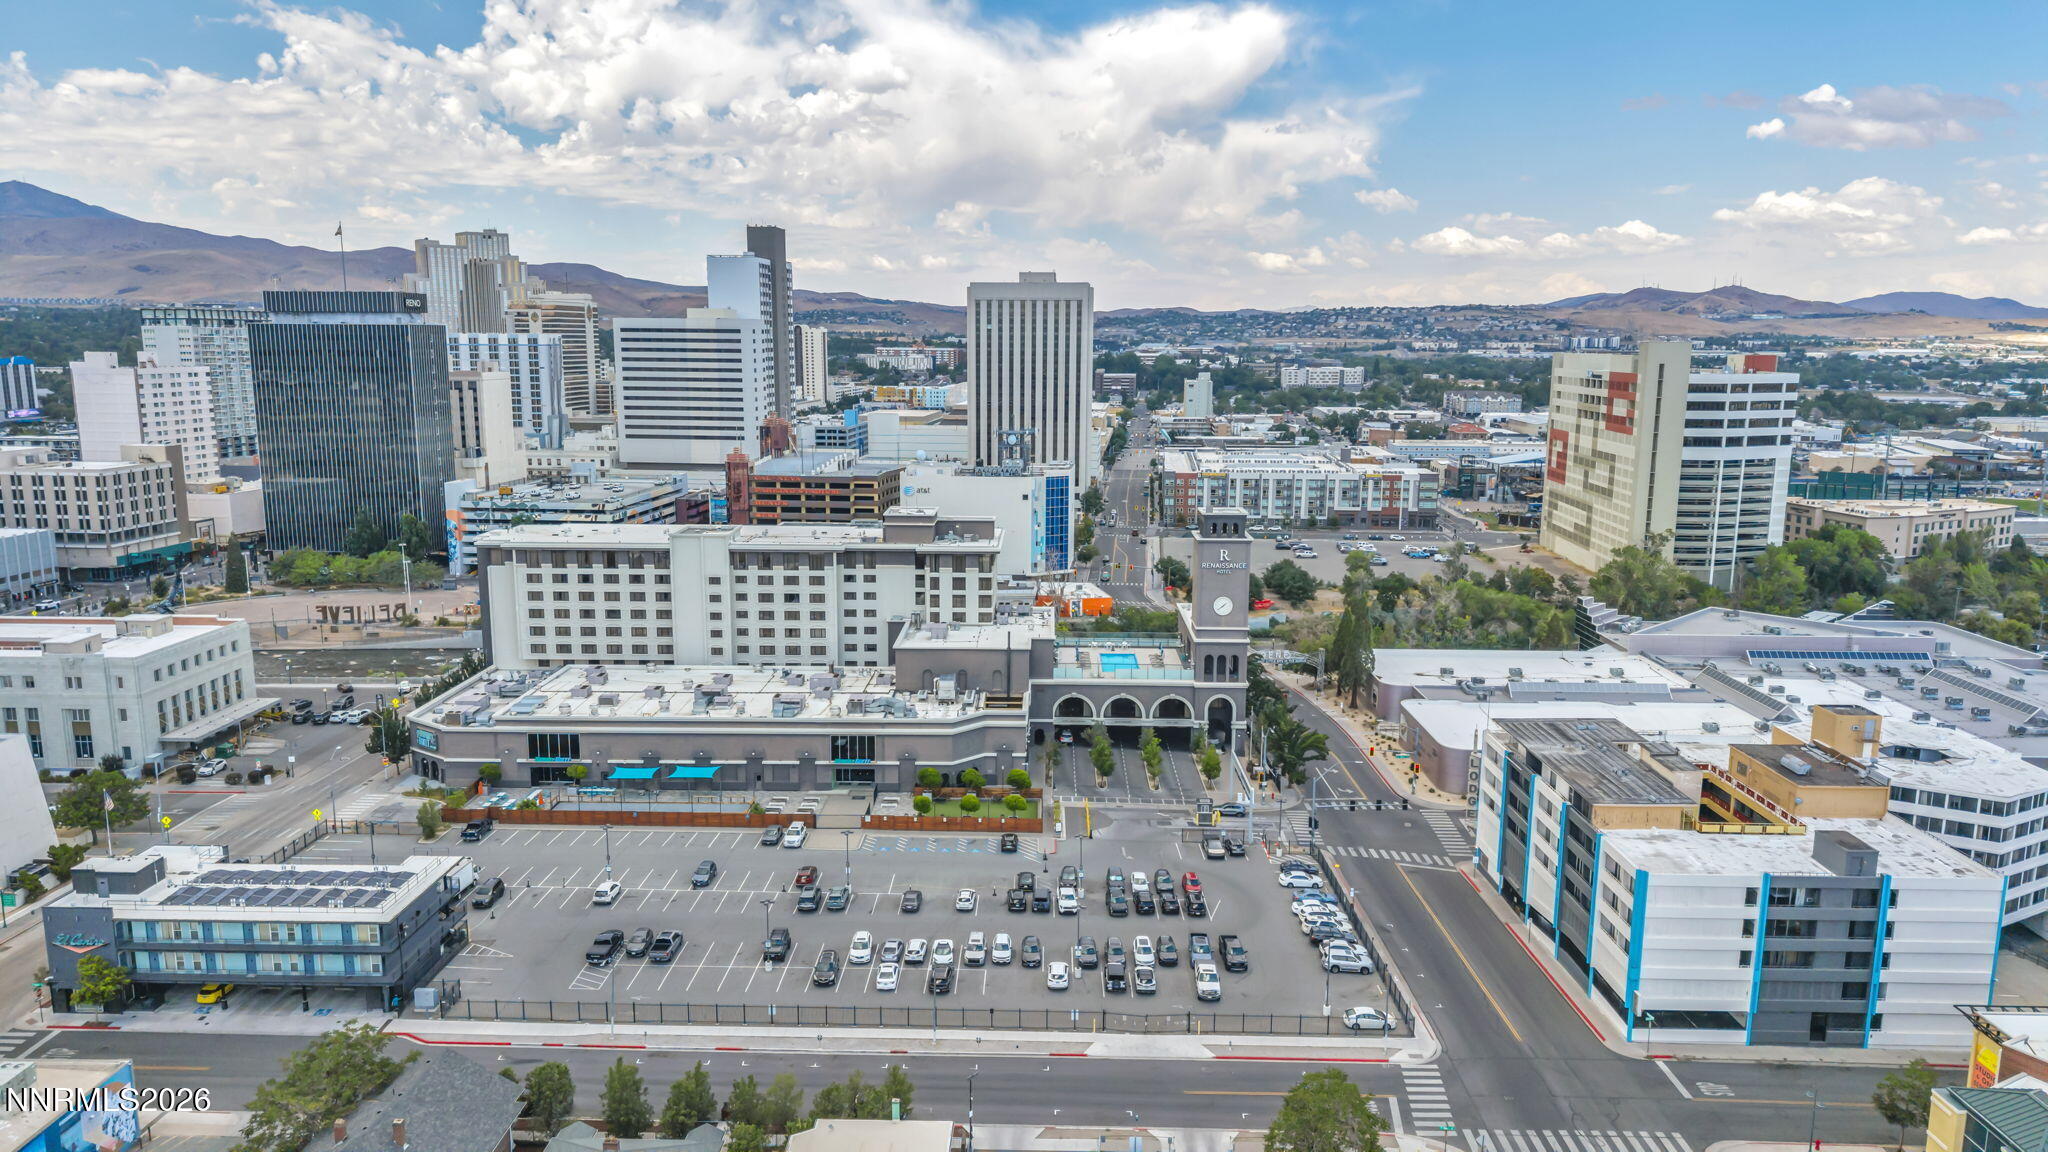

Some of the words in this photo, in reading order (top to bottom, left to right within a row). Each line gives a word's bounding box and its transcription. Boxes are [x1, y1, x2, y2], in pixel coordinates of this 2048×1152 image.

[405, 299, 421, 307] RENO
[1219, 549, 1231, 561] R
[1468, 758, 1479, 818] LODGE
